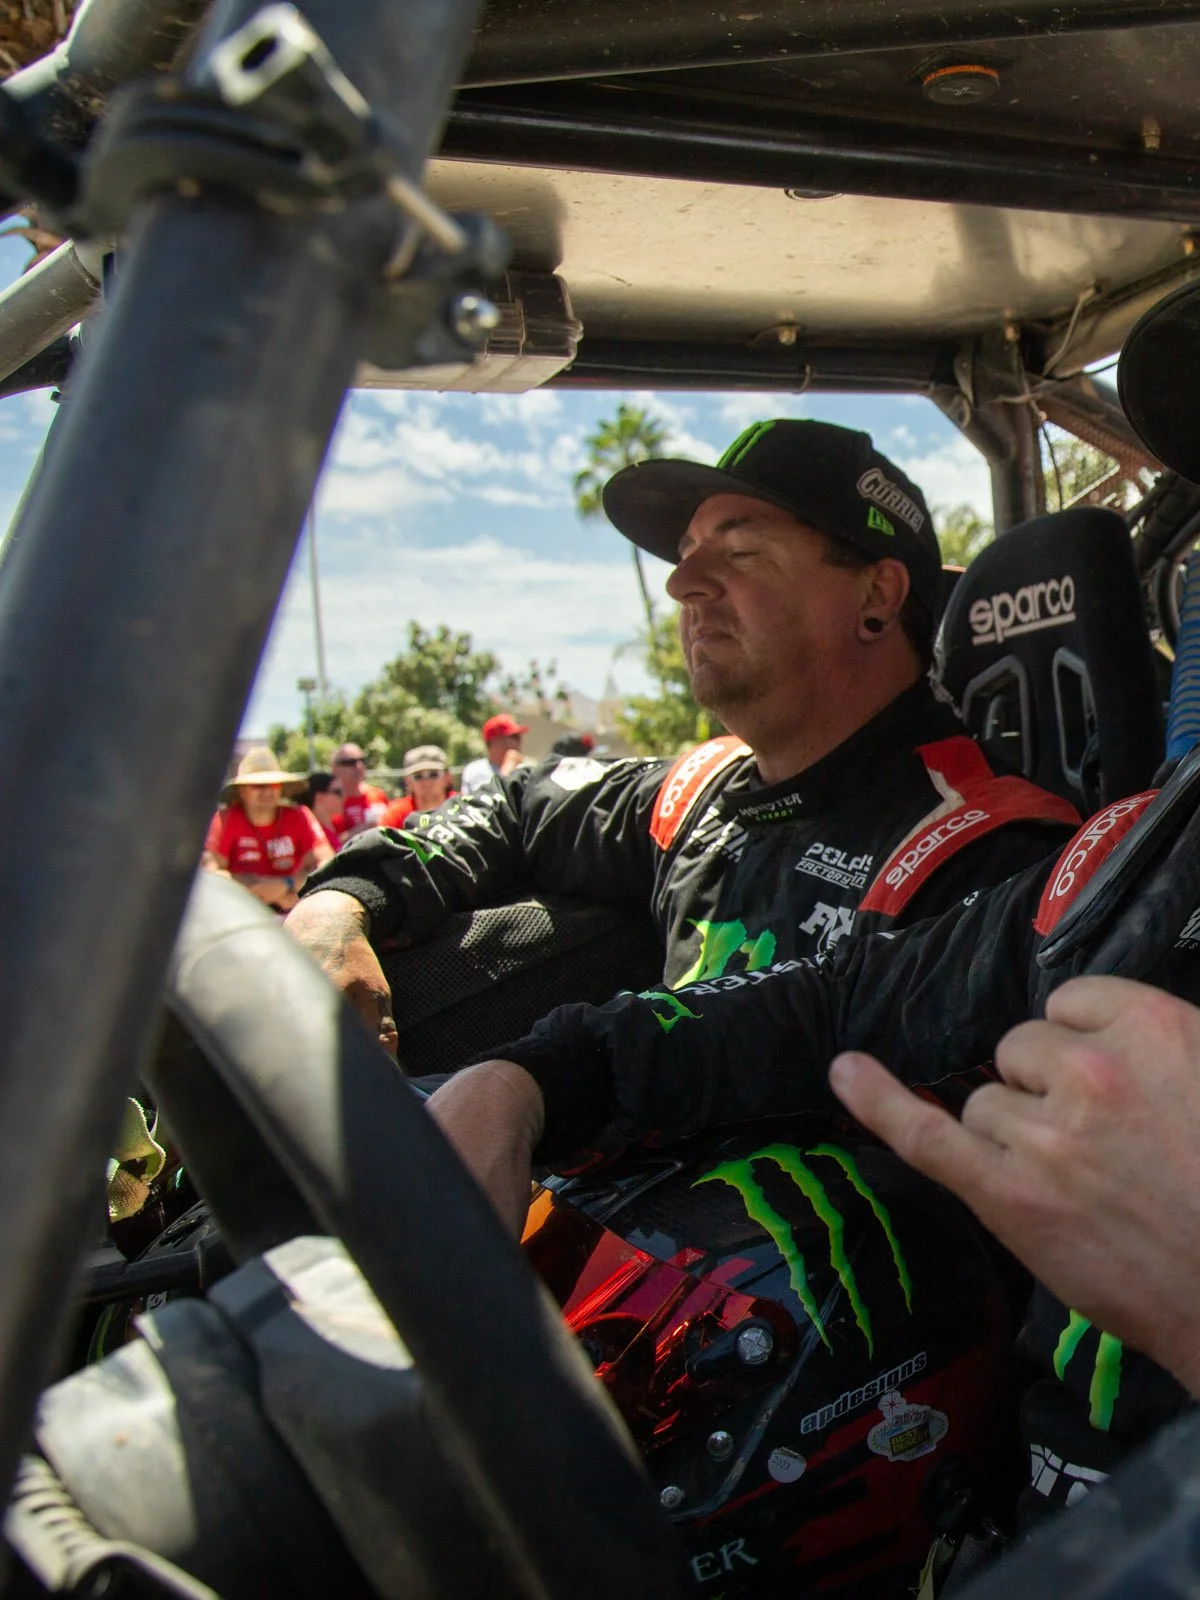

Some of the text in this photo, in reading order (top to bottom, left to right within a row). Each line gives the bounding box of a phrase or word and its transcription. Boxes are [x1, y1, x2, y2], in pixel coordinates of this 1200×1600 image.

[969, 575, 1075, 643] sparco
[885, 808, 984, 890] sparco
[800, 1351, 927, 1434] apdesigns
